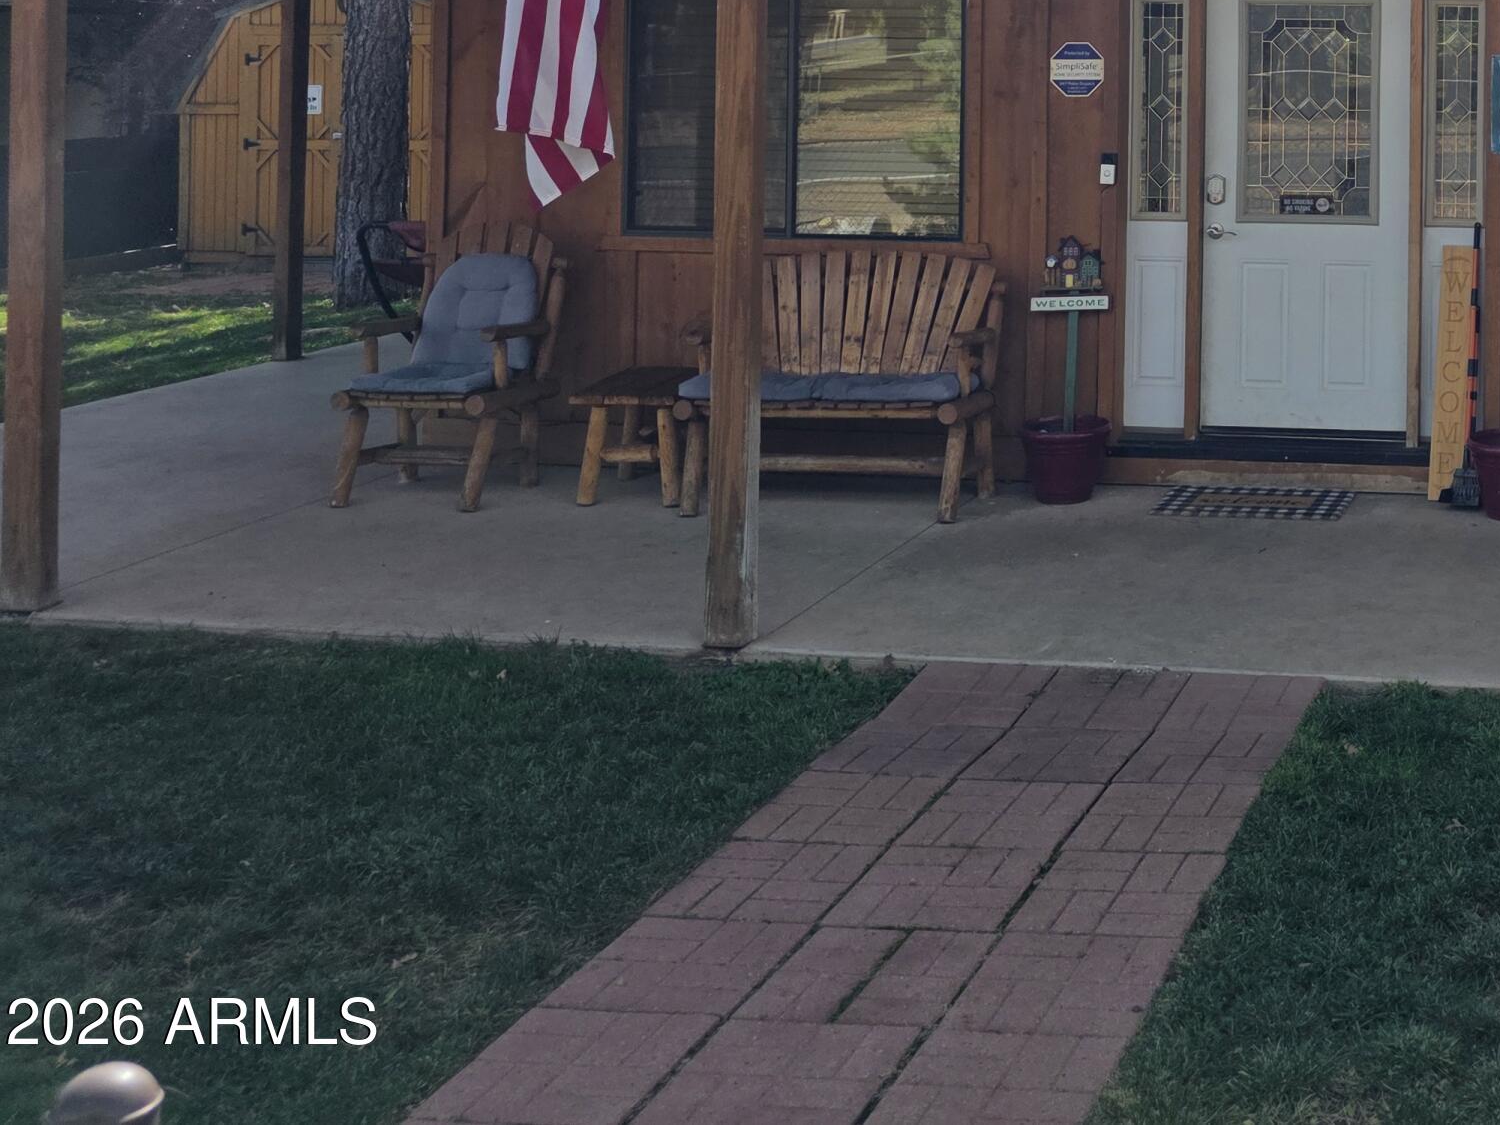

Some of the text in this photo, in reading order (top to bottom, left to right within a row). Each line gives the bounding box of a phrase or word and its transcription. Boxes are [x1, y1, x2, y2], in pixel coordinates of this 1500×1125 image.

[1056, 62, 1098, 71] SimpliSafe
[1035, 299, 1105, 308] WELCOME
[1436, 270, 1470, 475] WELCOME
